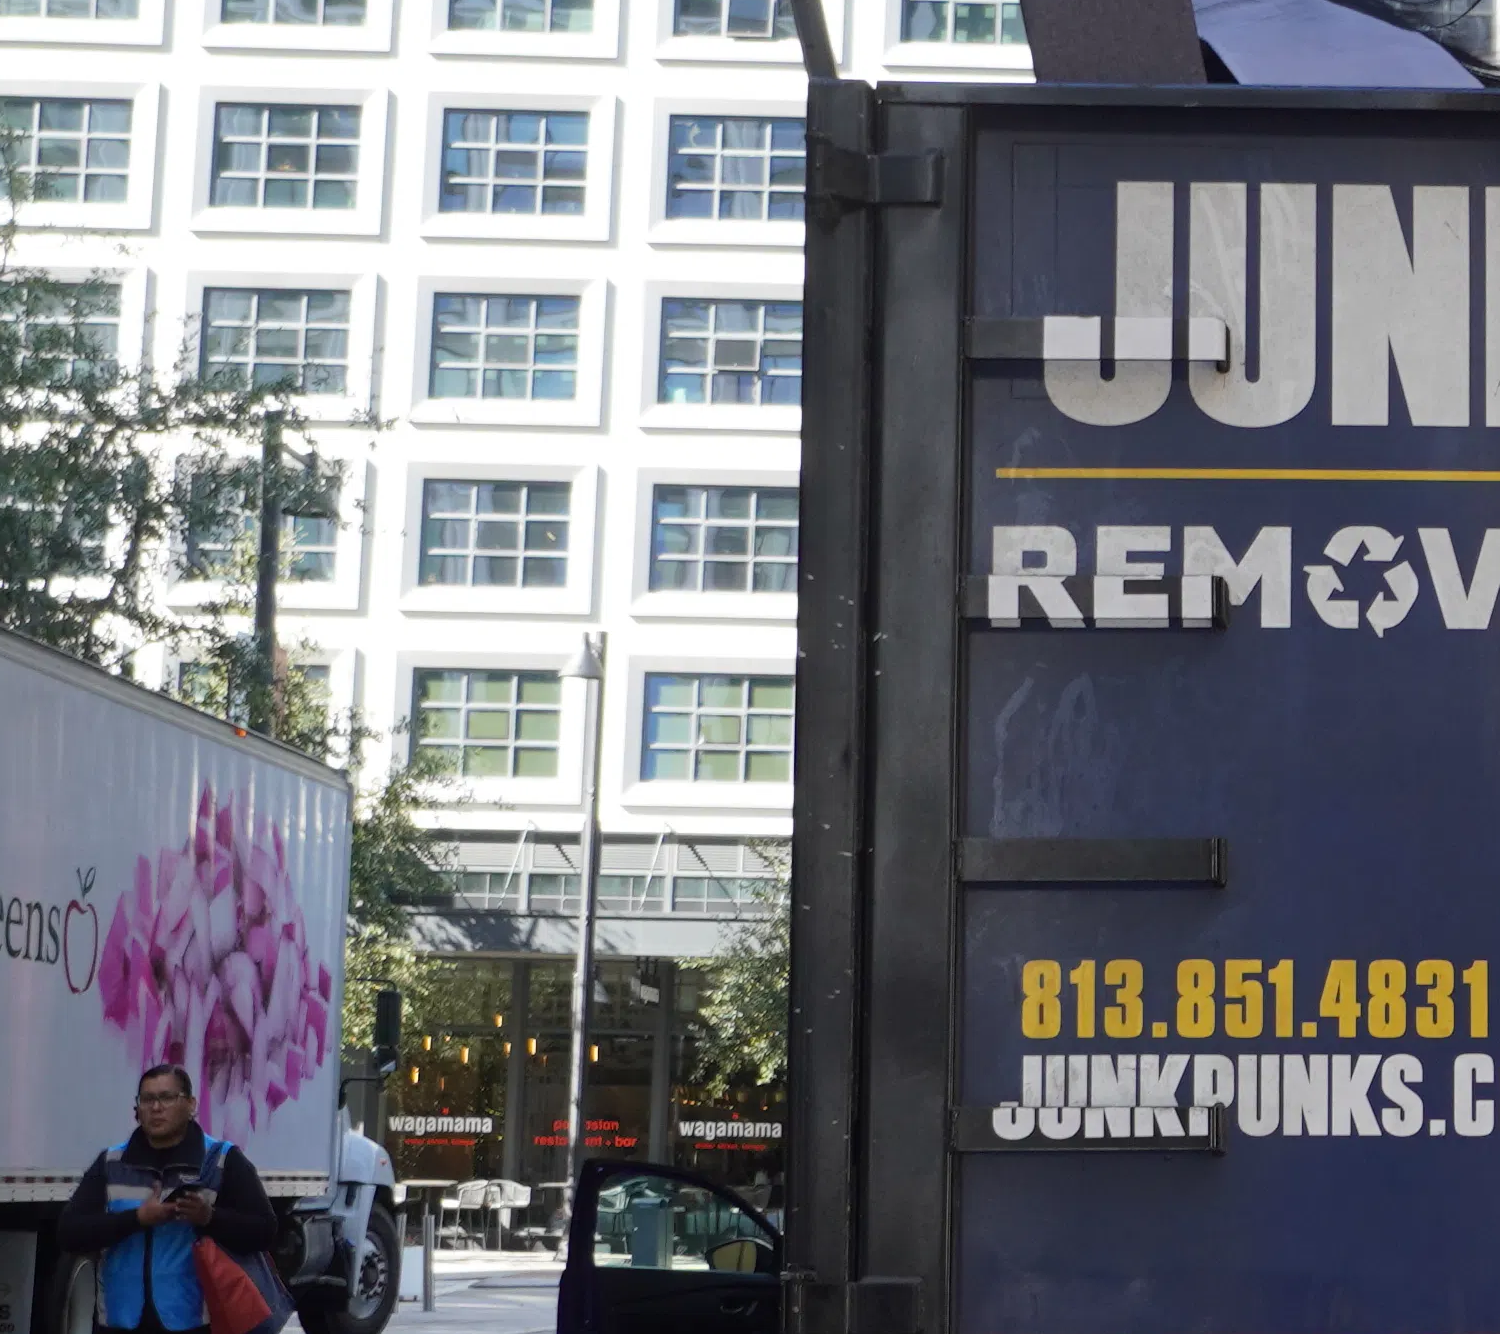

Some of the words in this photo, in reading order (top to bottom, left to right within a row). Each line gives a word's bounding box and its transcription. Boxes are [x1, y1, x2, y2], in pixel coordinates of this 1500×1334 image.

[1022, 959, 1488, 1039] 813.851.4831
[389, 1116, 493, 1136] wagamama
[679, 1120, 782, 1140] wagamama
